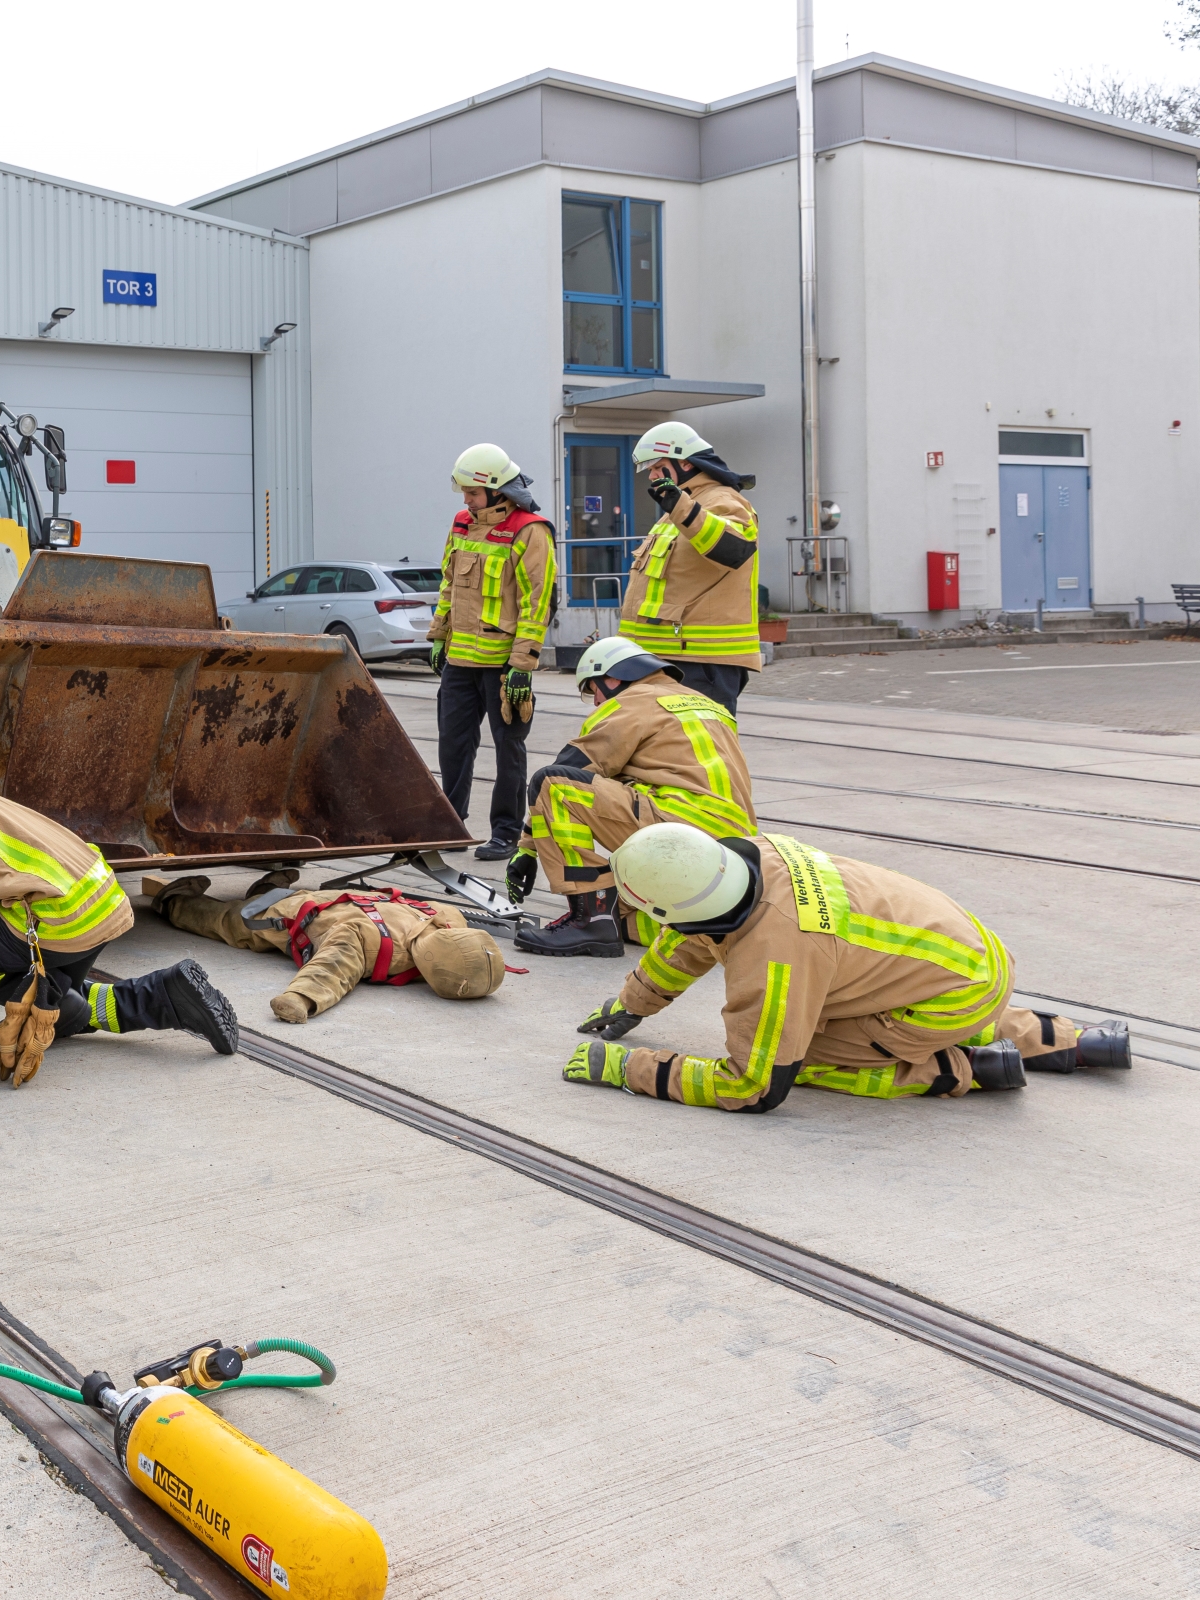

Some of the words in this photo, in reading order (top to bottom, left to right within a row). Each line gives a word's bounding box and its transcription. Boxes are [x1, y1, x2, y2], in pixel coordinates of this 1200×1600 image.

[106, 279, 141, 296] TOR
[144, 281, 154, 297] 3
[801, 854, 831, 930] Schachtanlage
[155, 1464, 191, 1509] MSA
[195, 1499, 231, 1541] AUER
